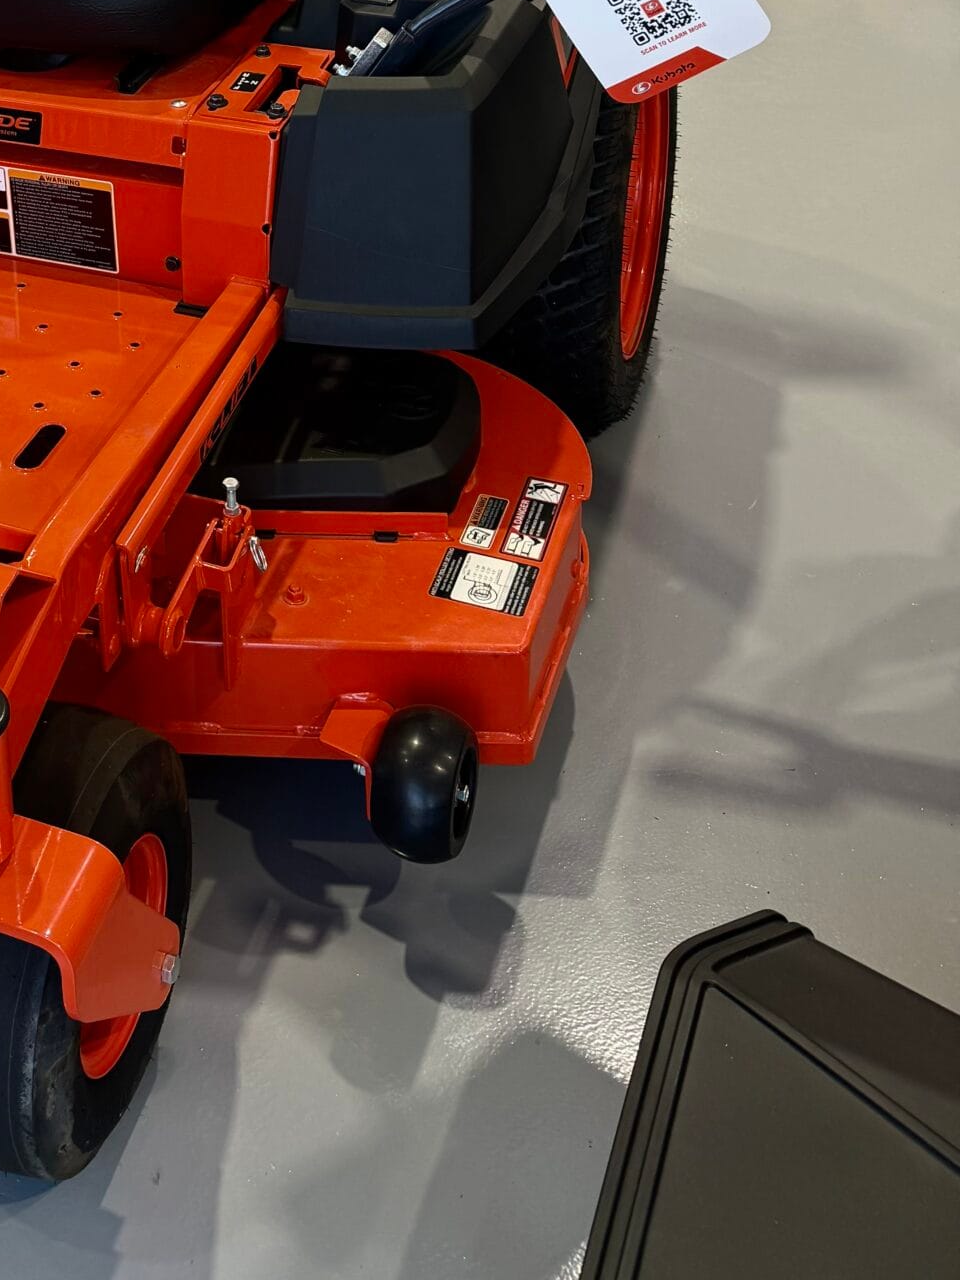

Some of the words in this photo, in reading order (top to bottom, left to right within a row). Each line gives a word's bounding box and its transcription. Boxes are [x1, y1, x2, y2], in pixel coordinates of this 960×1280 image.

[640, 44, 658, 56] SCAN
[658, 40, 668, 48] TO
[667, 31, 688, 43] LEARN
[688, 22, 707, 34] MORE
[650, 62, 696, 85] Kubota
[44, 175, 81, 187] WARNING
[514, 499, 531, 524] DANGER
